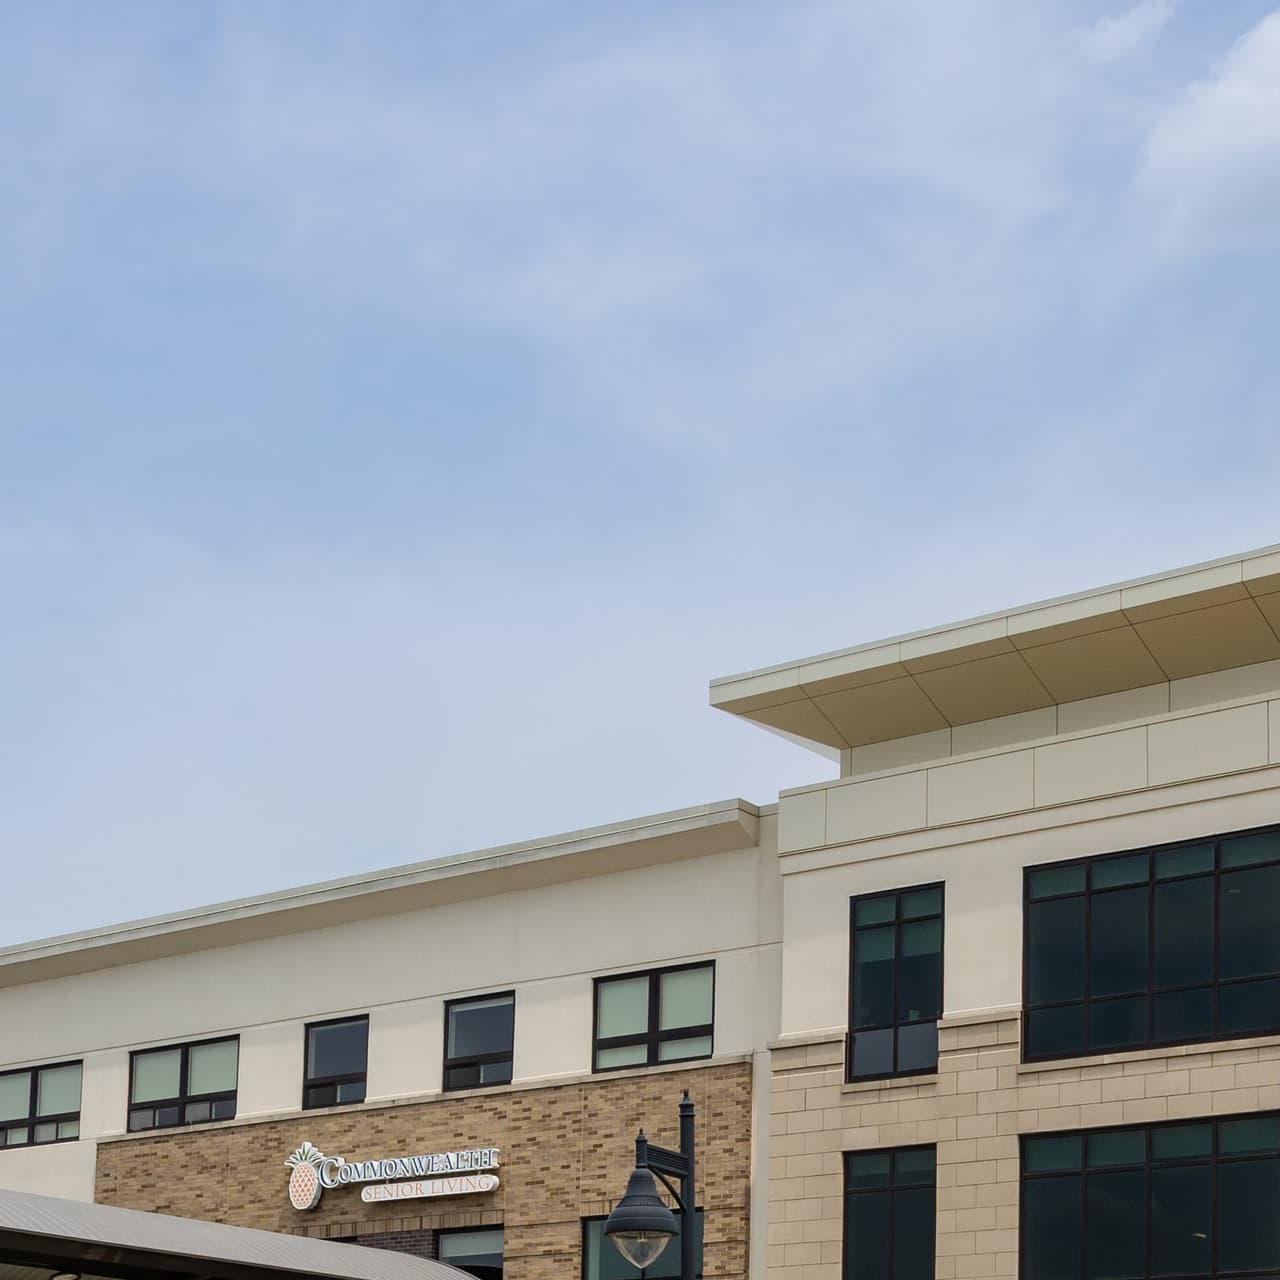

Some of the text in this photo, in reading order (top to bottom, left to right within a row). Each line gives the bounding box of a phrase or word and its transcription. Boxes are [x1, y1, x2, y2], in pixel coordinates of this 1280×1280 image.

[320, 1149, 496, 1188] COMMONWEALTH
[365, 1176, 491, 1199] SENIOR LIVING
